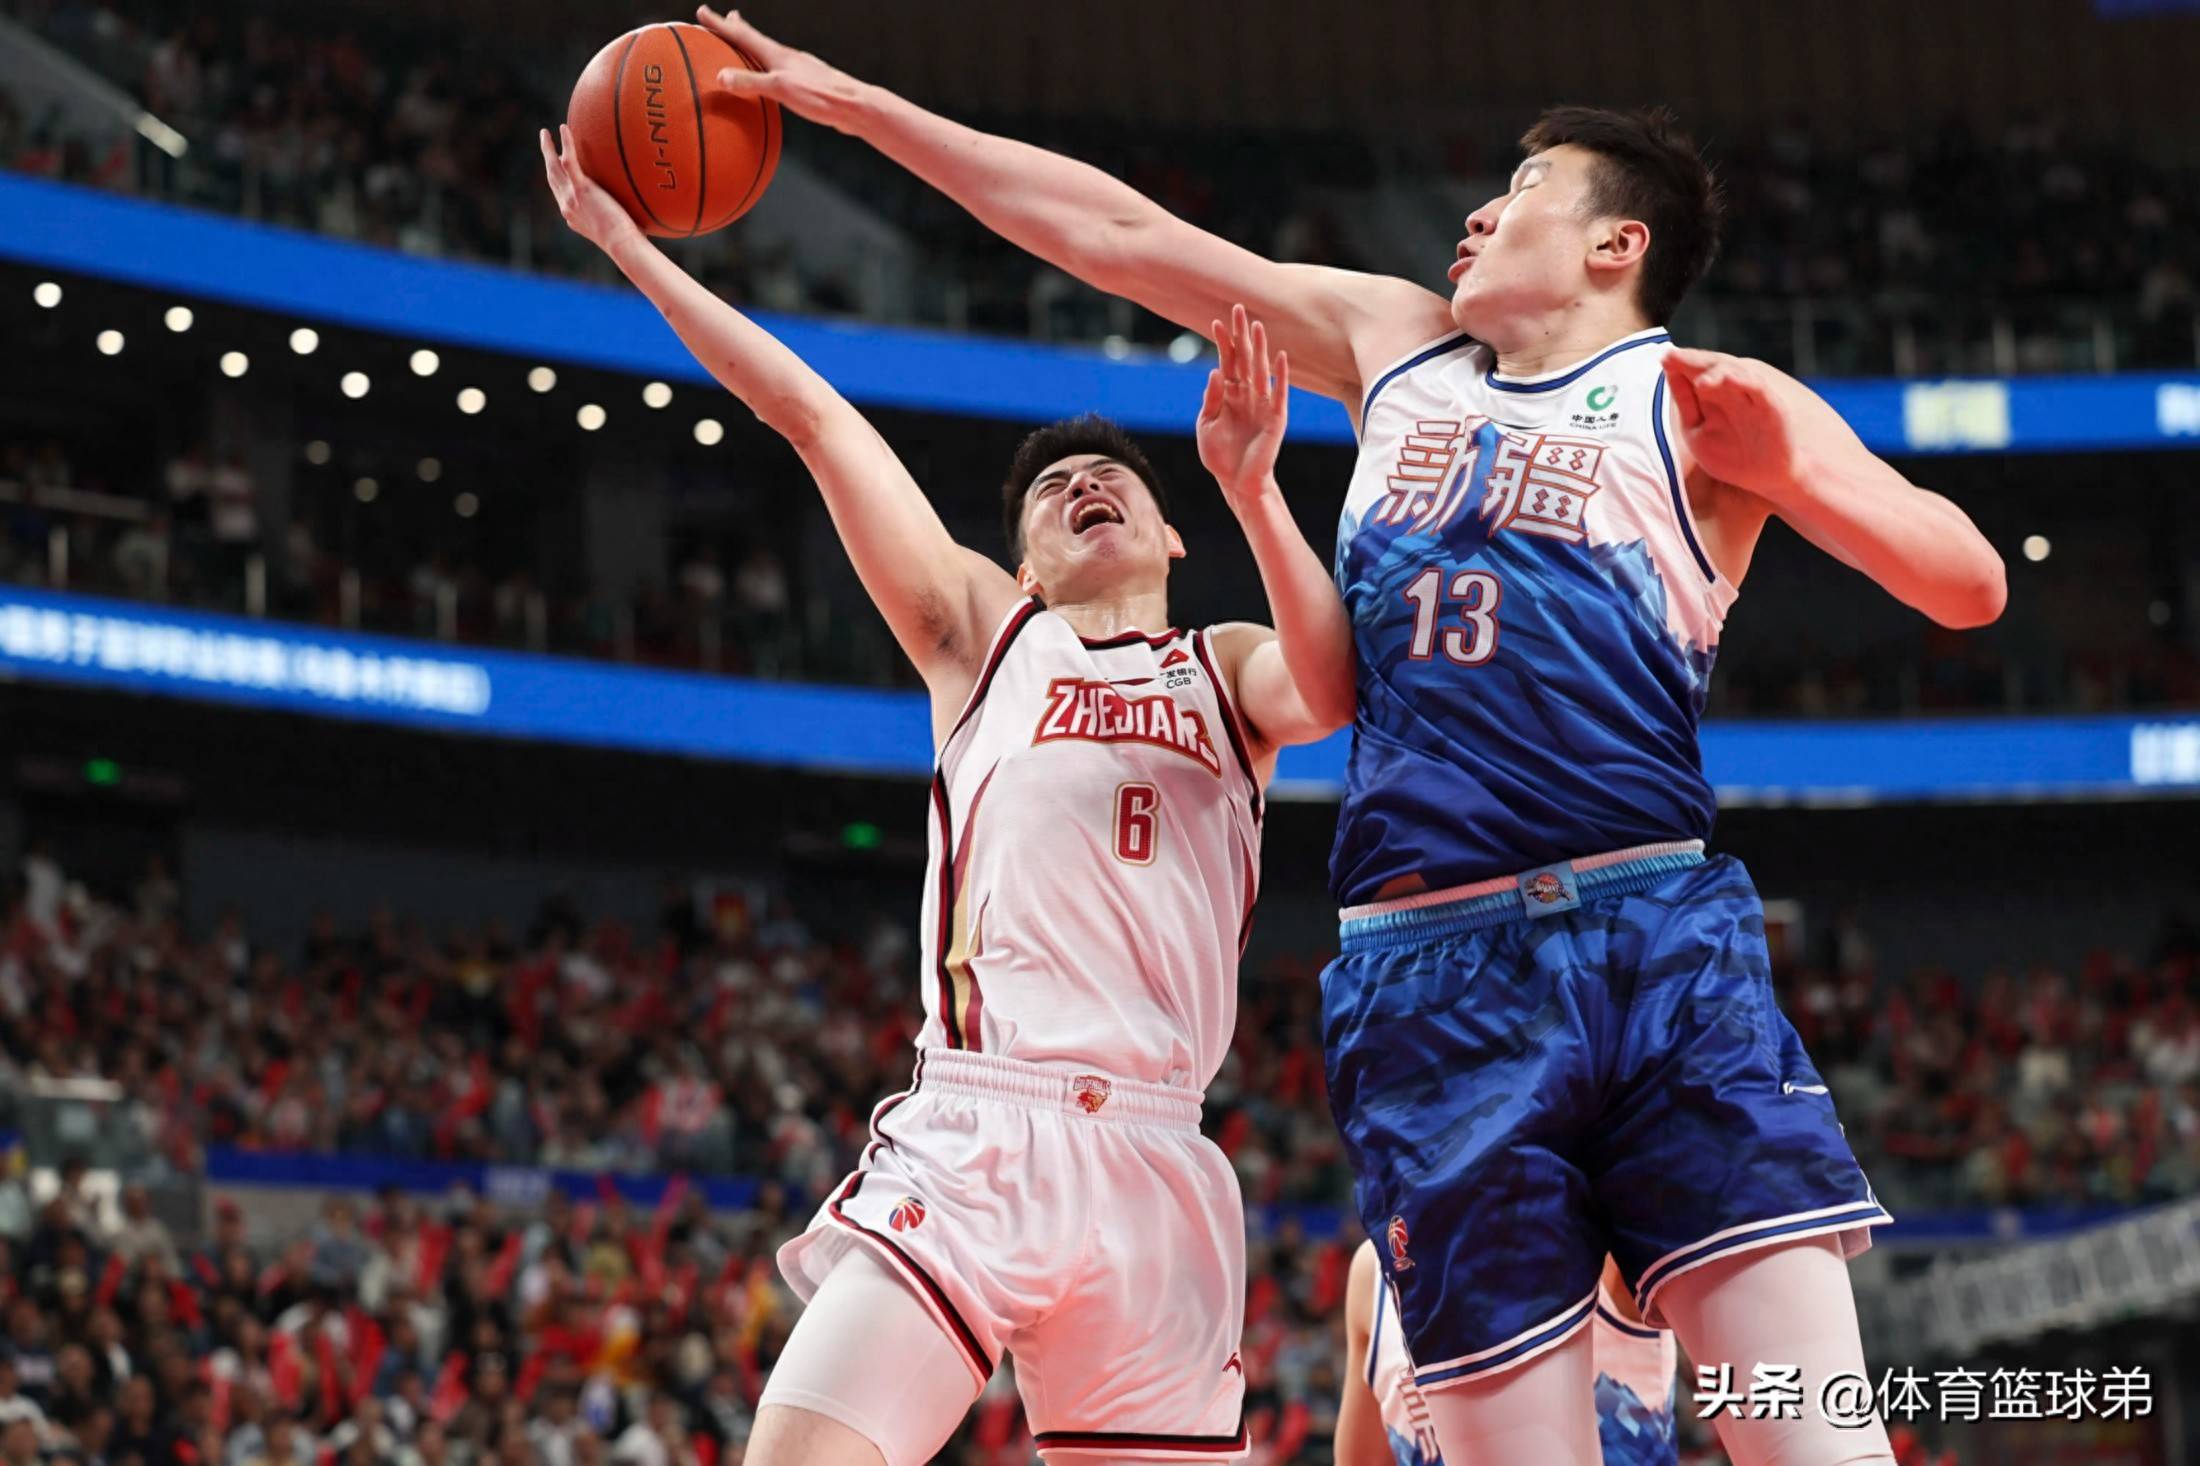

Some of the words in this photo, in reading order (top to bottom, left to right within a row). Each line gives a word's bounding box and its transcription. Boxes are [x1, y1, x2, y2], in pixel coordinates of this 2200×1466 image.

[644, 64, 677, 190] LI-NING
[1373, 415, 1608, 544] 新疆
[1403, 567, 1502, 669] 13
[1160, 667, 1197, 678] 发银行
[1166, 677, 1192, 689] CGB
[1114, 782, 1160, 867] 6
